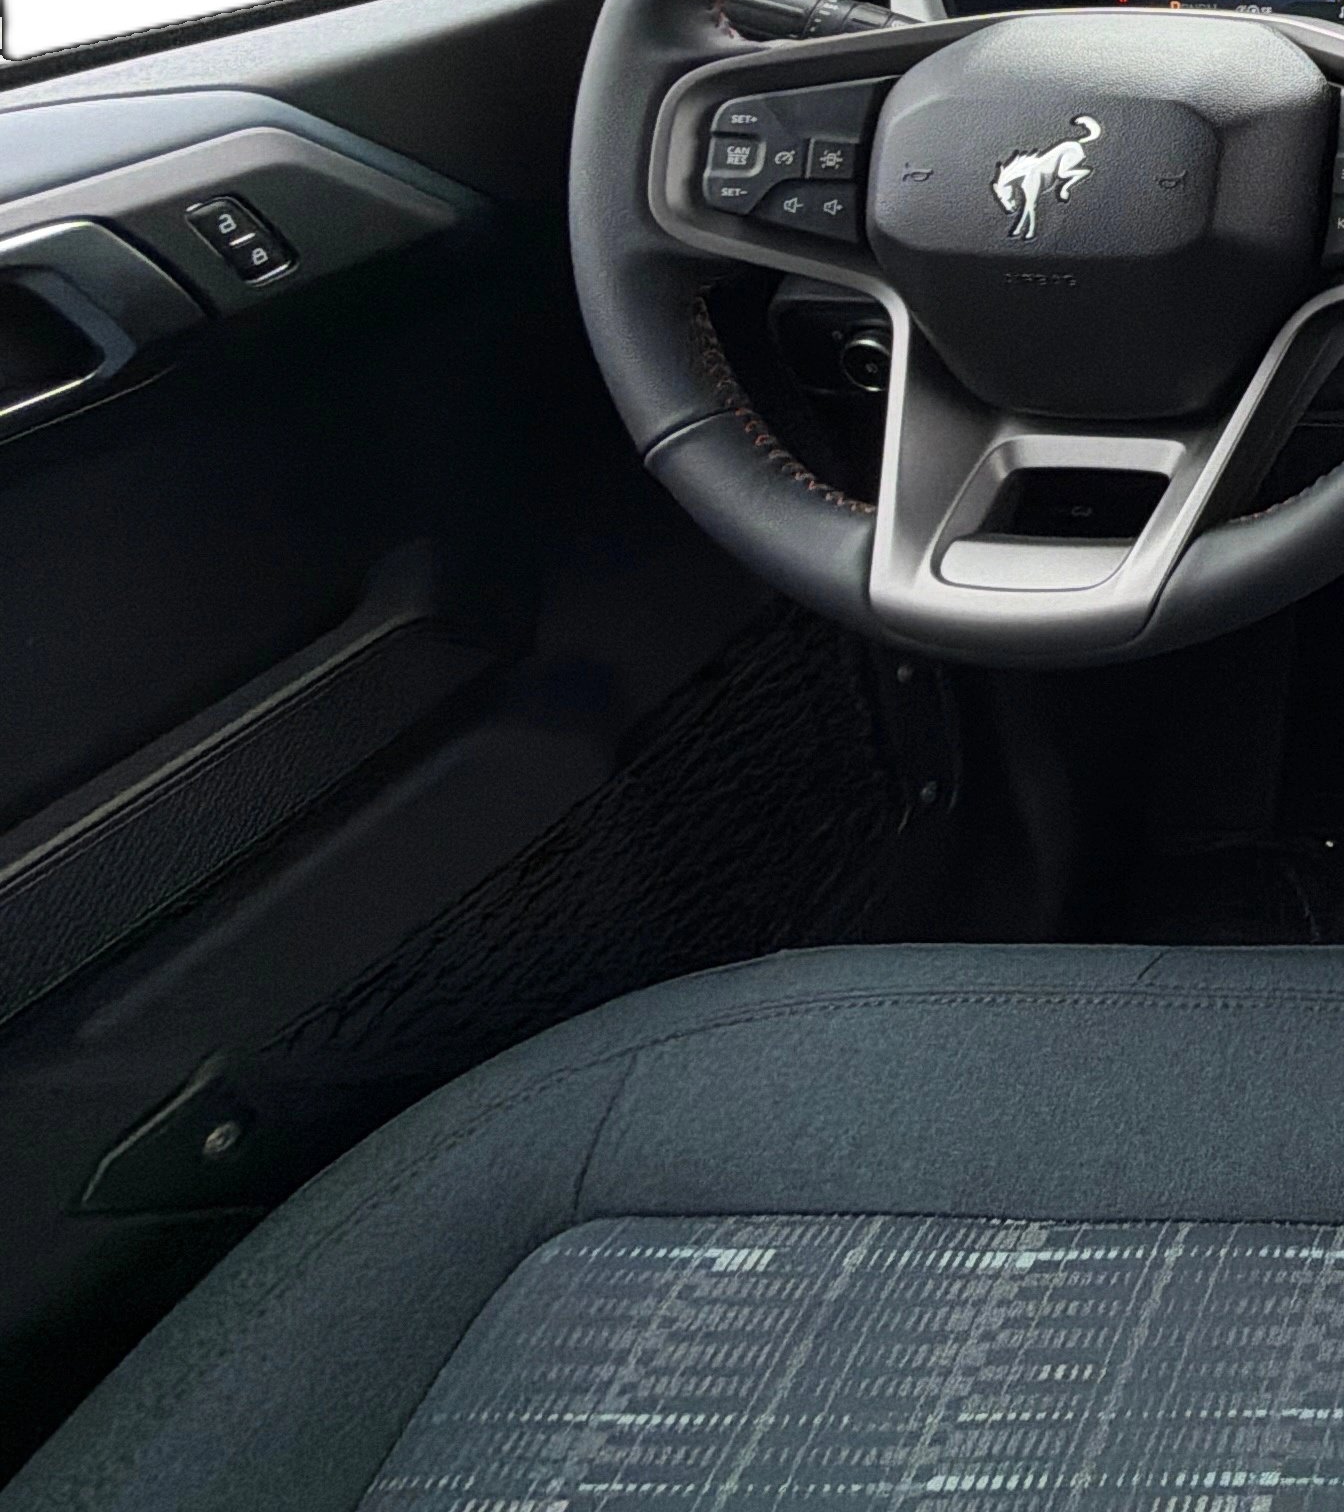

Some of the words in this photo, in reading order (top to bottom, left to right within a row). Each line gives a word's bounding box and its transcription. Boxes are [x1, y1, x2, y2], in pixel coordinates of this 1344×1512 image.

[731, 115, 758, 124] SET+
[727, 146, 750, 155] CAN
[726, 156, 747, 165] RES
[721, 188, 748, 197] SET-
